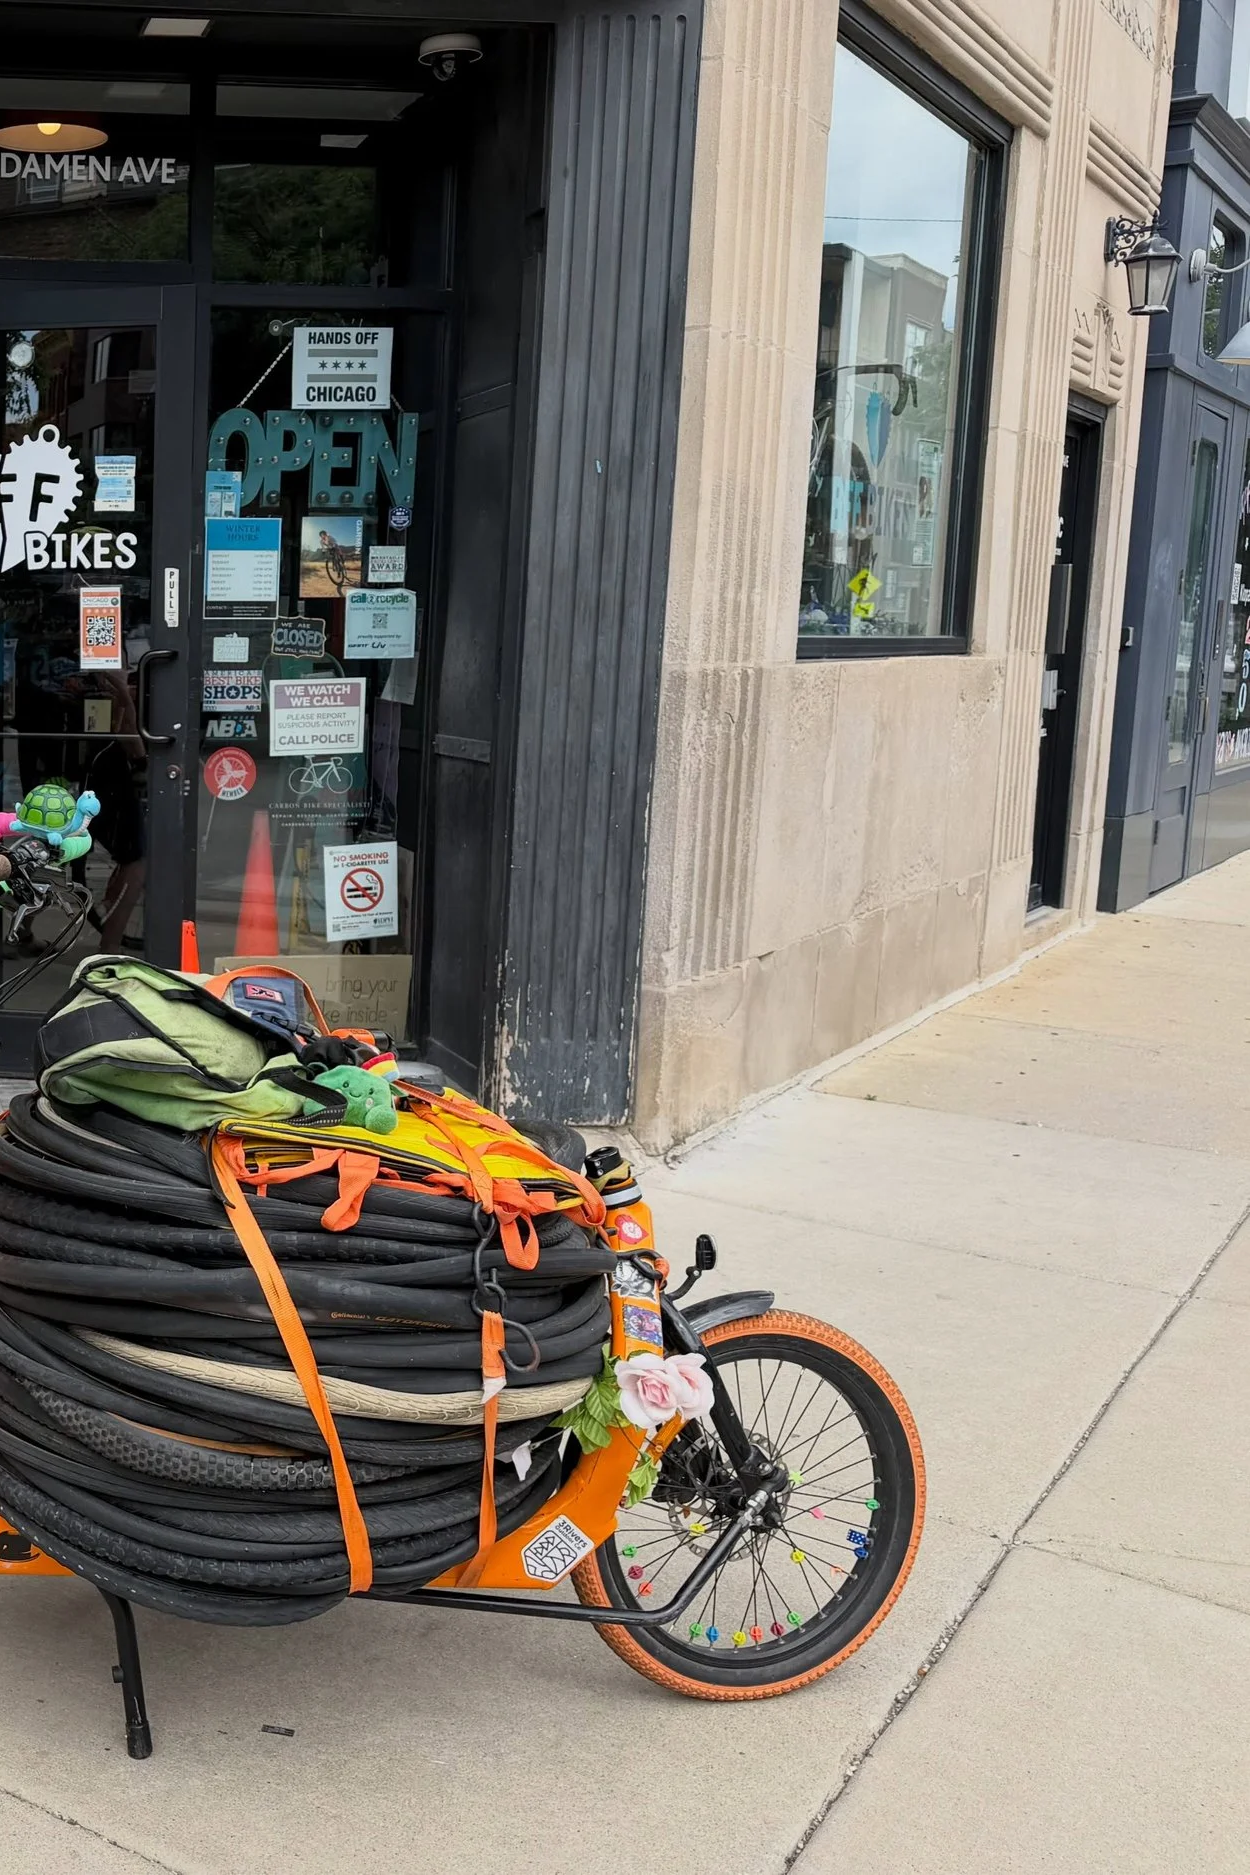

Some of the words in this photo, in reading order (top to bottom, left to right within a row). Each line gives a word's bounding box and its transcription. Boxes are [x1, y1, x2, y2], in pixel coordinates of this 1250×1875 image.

[0, 152, 112, 182] DAMEN
[118, 157, 176, 184] AVE
[308, 332, 351, 345] HANDS
[355, 332, 379, 345] OFF
[306, 386, 377, 402] CHICAGO
[208, 407, 419, 508] OPEN
[225, 524, 261, 533] WINTER
[227, 533, 259, 542] HOURS
[25, 532, 138, 570] BIKES
[275, 628, 323, 647] CLOSED
[204, 676, 233, 685] BEST
[236, 676, 261, 685] BIKE
[204, 685, 261, 699] SHOPS
[284, 686, 305, 696] WE
[307, 684, 351, 695] WATCH
[290, 697, 312, 707] WE
[313, 695, 345, 706] CALL
[278, 721, 321, 729] SUSPICIOUS
[322, 719, 357, 727] ACTIVITY
[279, 735, 310, 746] CALL
[311, 734, 355, 744] POLICE
[349, 851, 389, 861] SMOKING
[341, 860, 376, 868] E-CIGARETTE
[325, 966, 363, 1000] bring
[367, 977, 399, 1000] your
[345, 998, 388, 1024] inside
